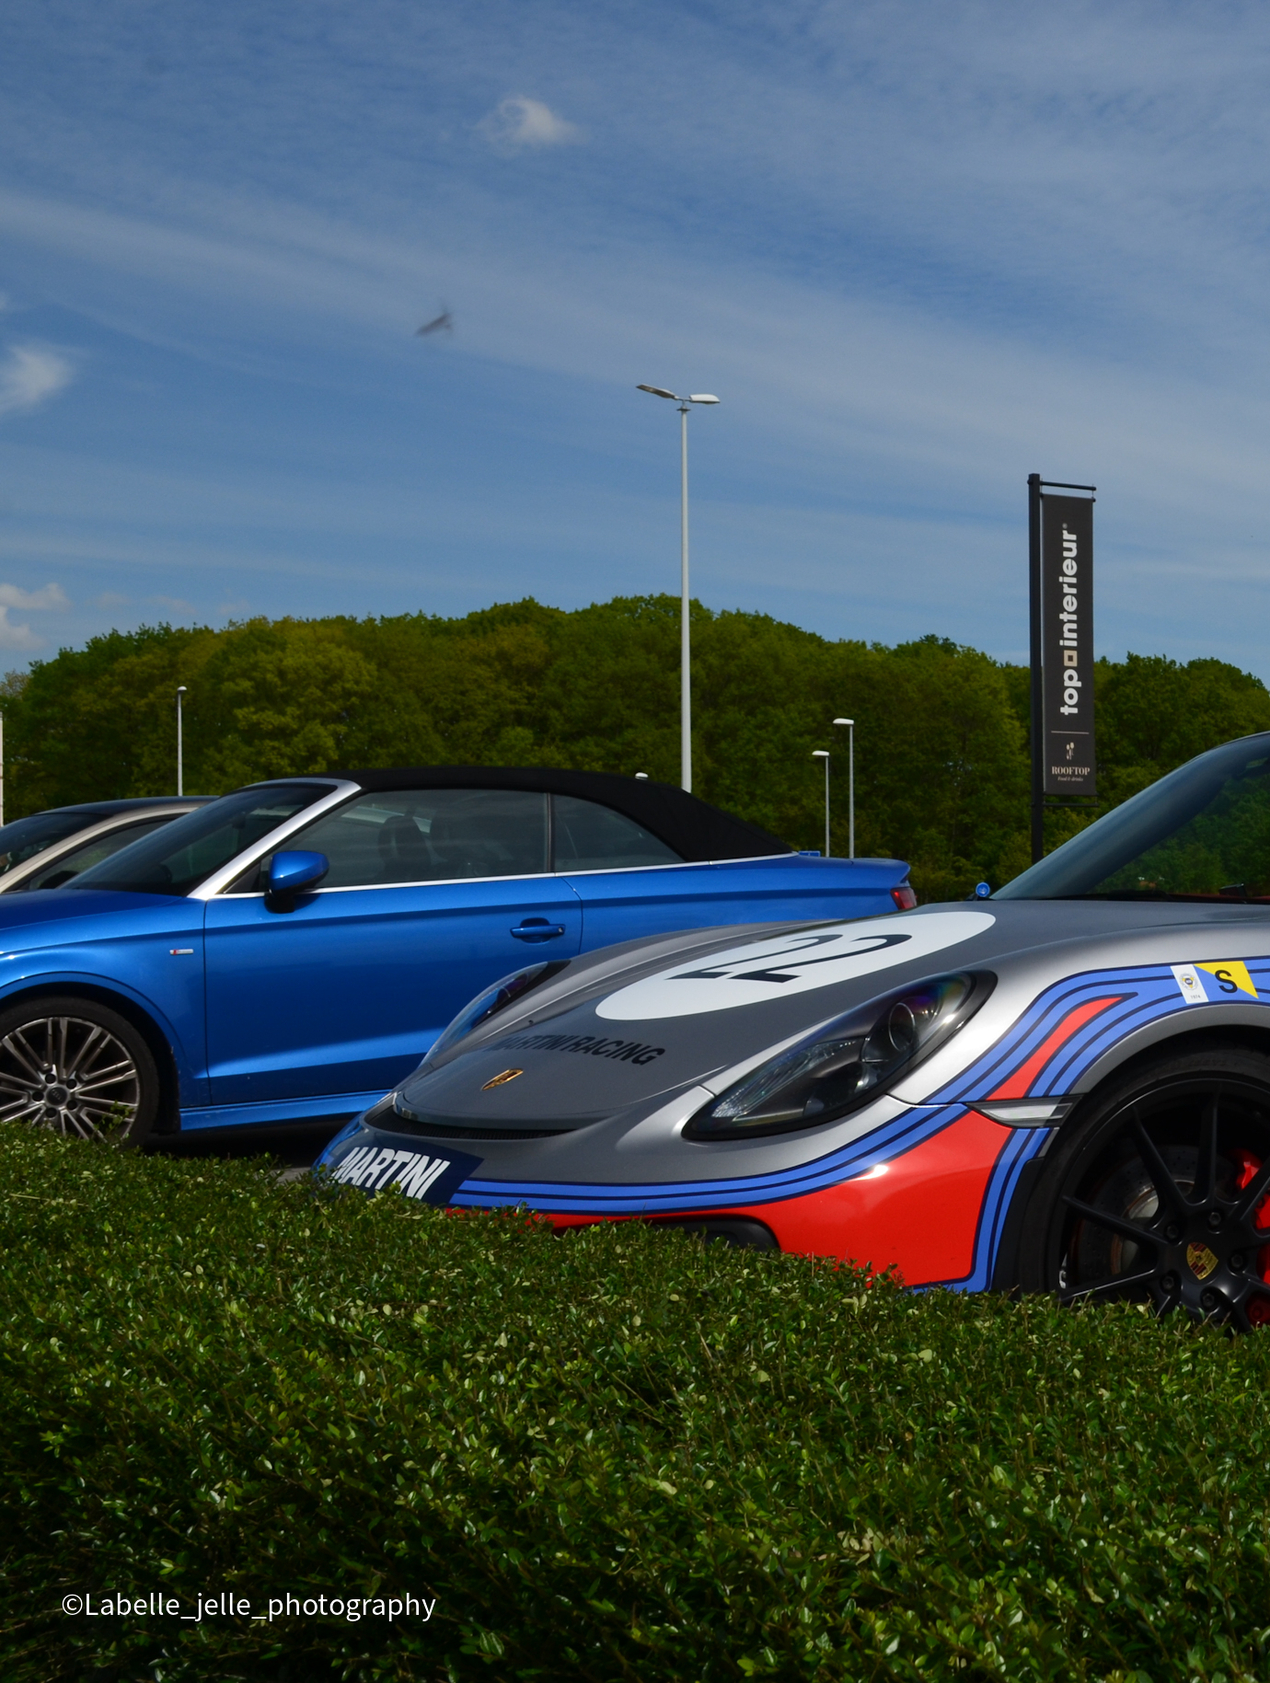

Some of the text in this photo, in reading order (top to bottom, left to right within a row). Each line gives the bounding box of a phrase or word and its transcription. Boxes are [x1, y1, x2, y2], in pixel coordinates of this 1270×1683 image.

[1051, 766, 1090, 775] ROOFTOP
[664, 934, 912, 984] 22
[1214, 969, 1238, 994] S
[567, 1036, 666, 1065] RACING
[326, 1146, 451, 1200] MARTINI
